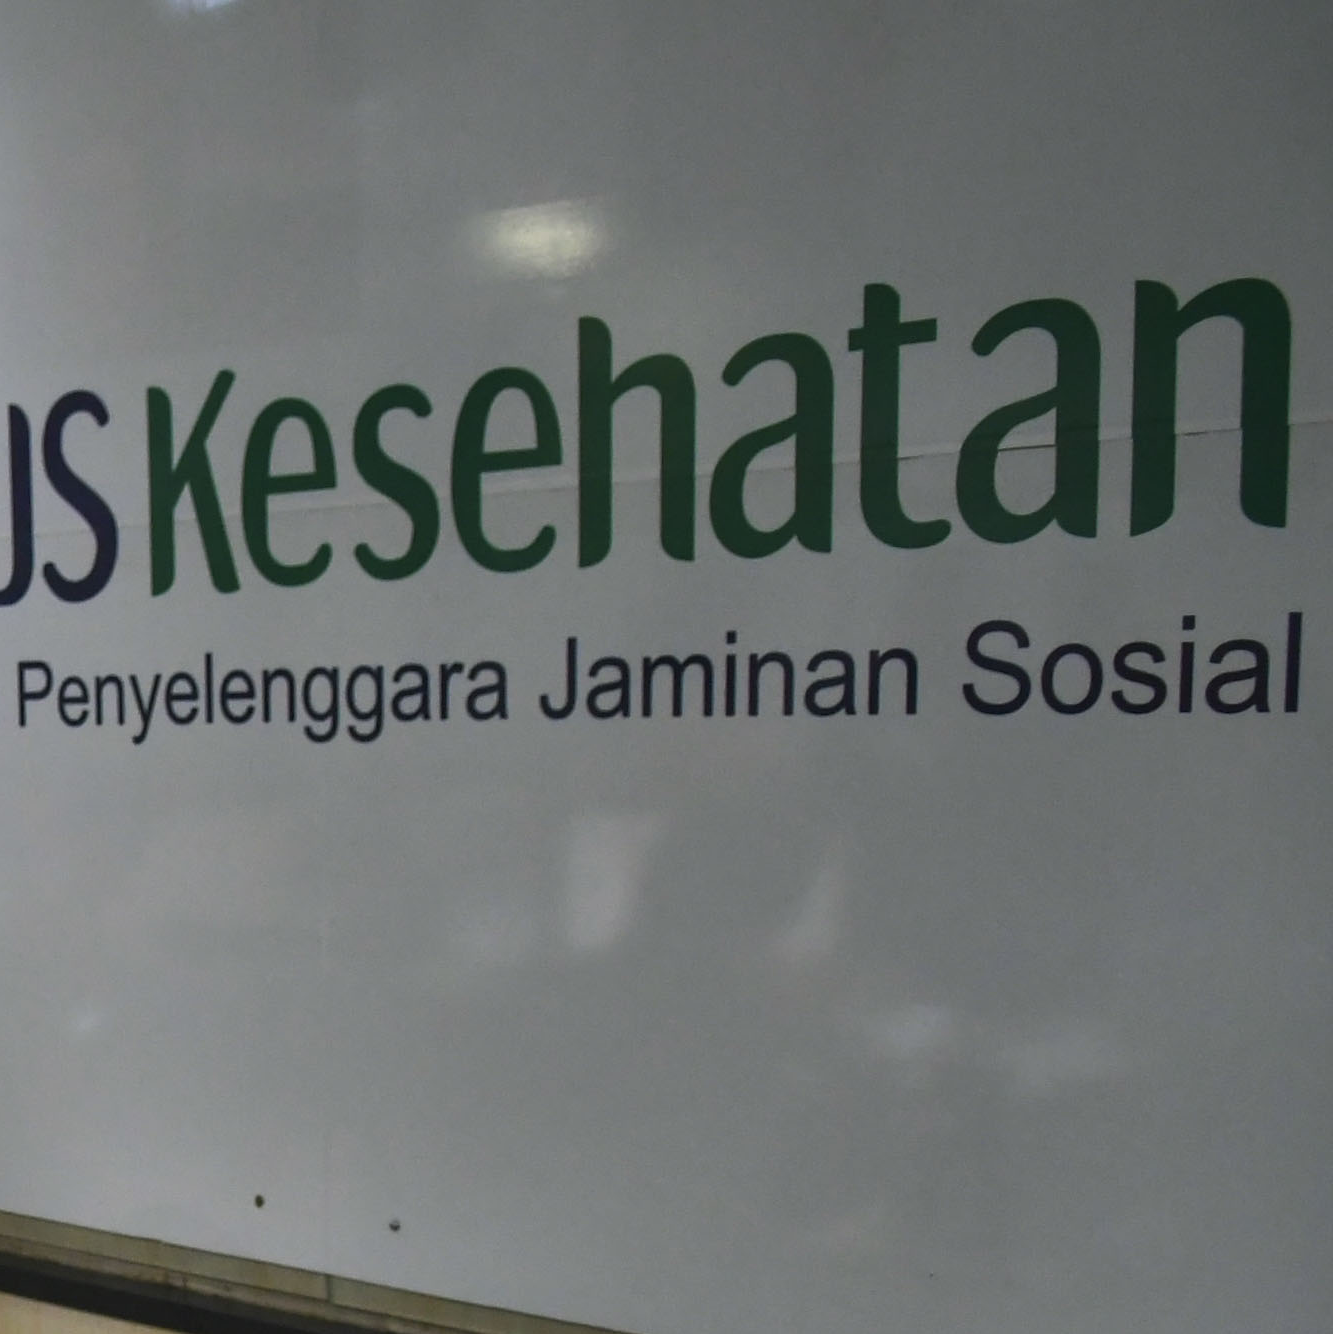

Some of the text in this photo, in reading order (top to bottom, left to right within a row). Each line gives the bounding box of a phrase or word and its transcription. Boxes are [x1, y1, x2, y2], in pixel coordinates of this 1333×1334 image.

[146, 276, 1292, 597] Kesehatan
[17, 653, 509, 745] Penyelenggara
[538, 630, 919, 722] Jaminan
[962, 611, 1304, 717] Sosial
